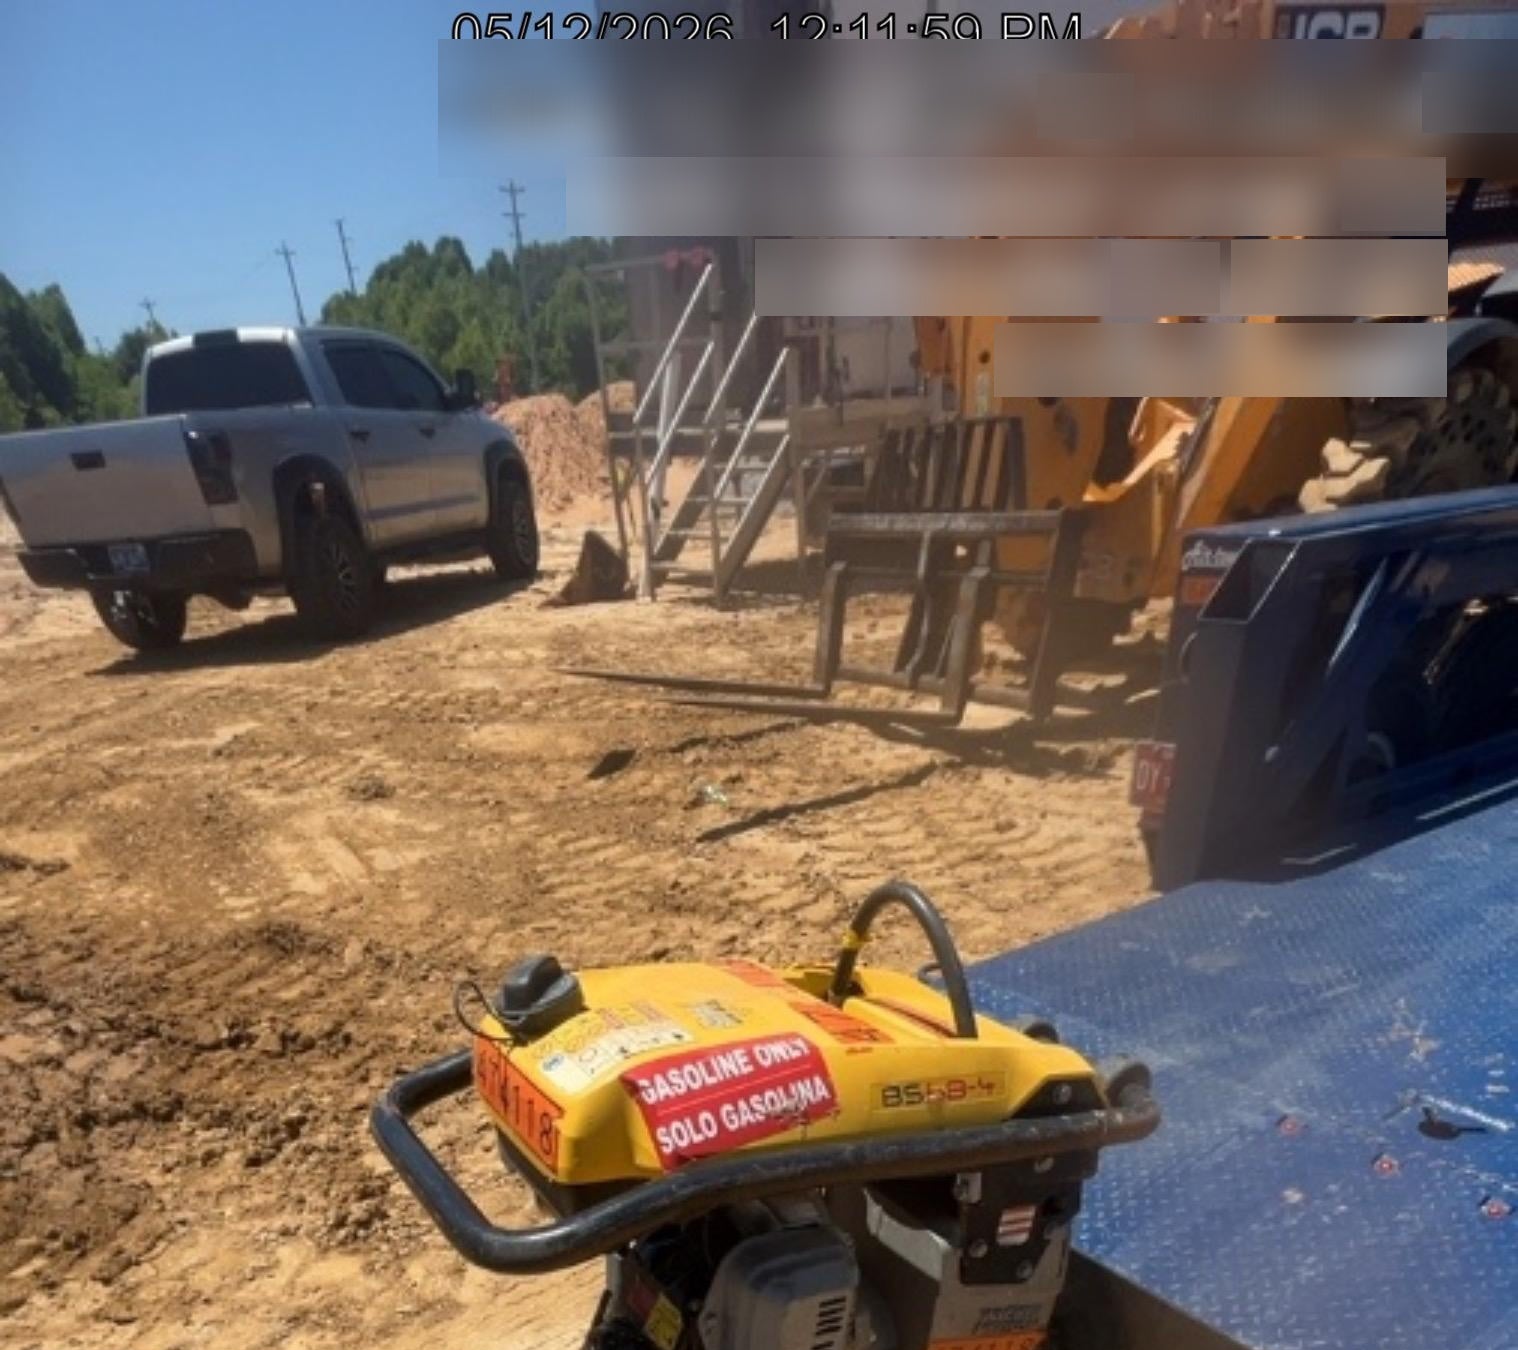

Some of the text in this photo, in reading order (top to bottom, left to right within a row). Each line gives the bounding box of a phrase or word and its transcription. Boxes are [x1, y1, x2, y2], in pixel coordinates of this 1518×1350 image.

[637, 1048, 755, 1105] GASOLINE
[752, 1037, 811, 1067] ONLY
[655, 1073, 831, 1155] SOLO GASOLINA
